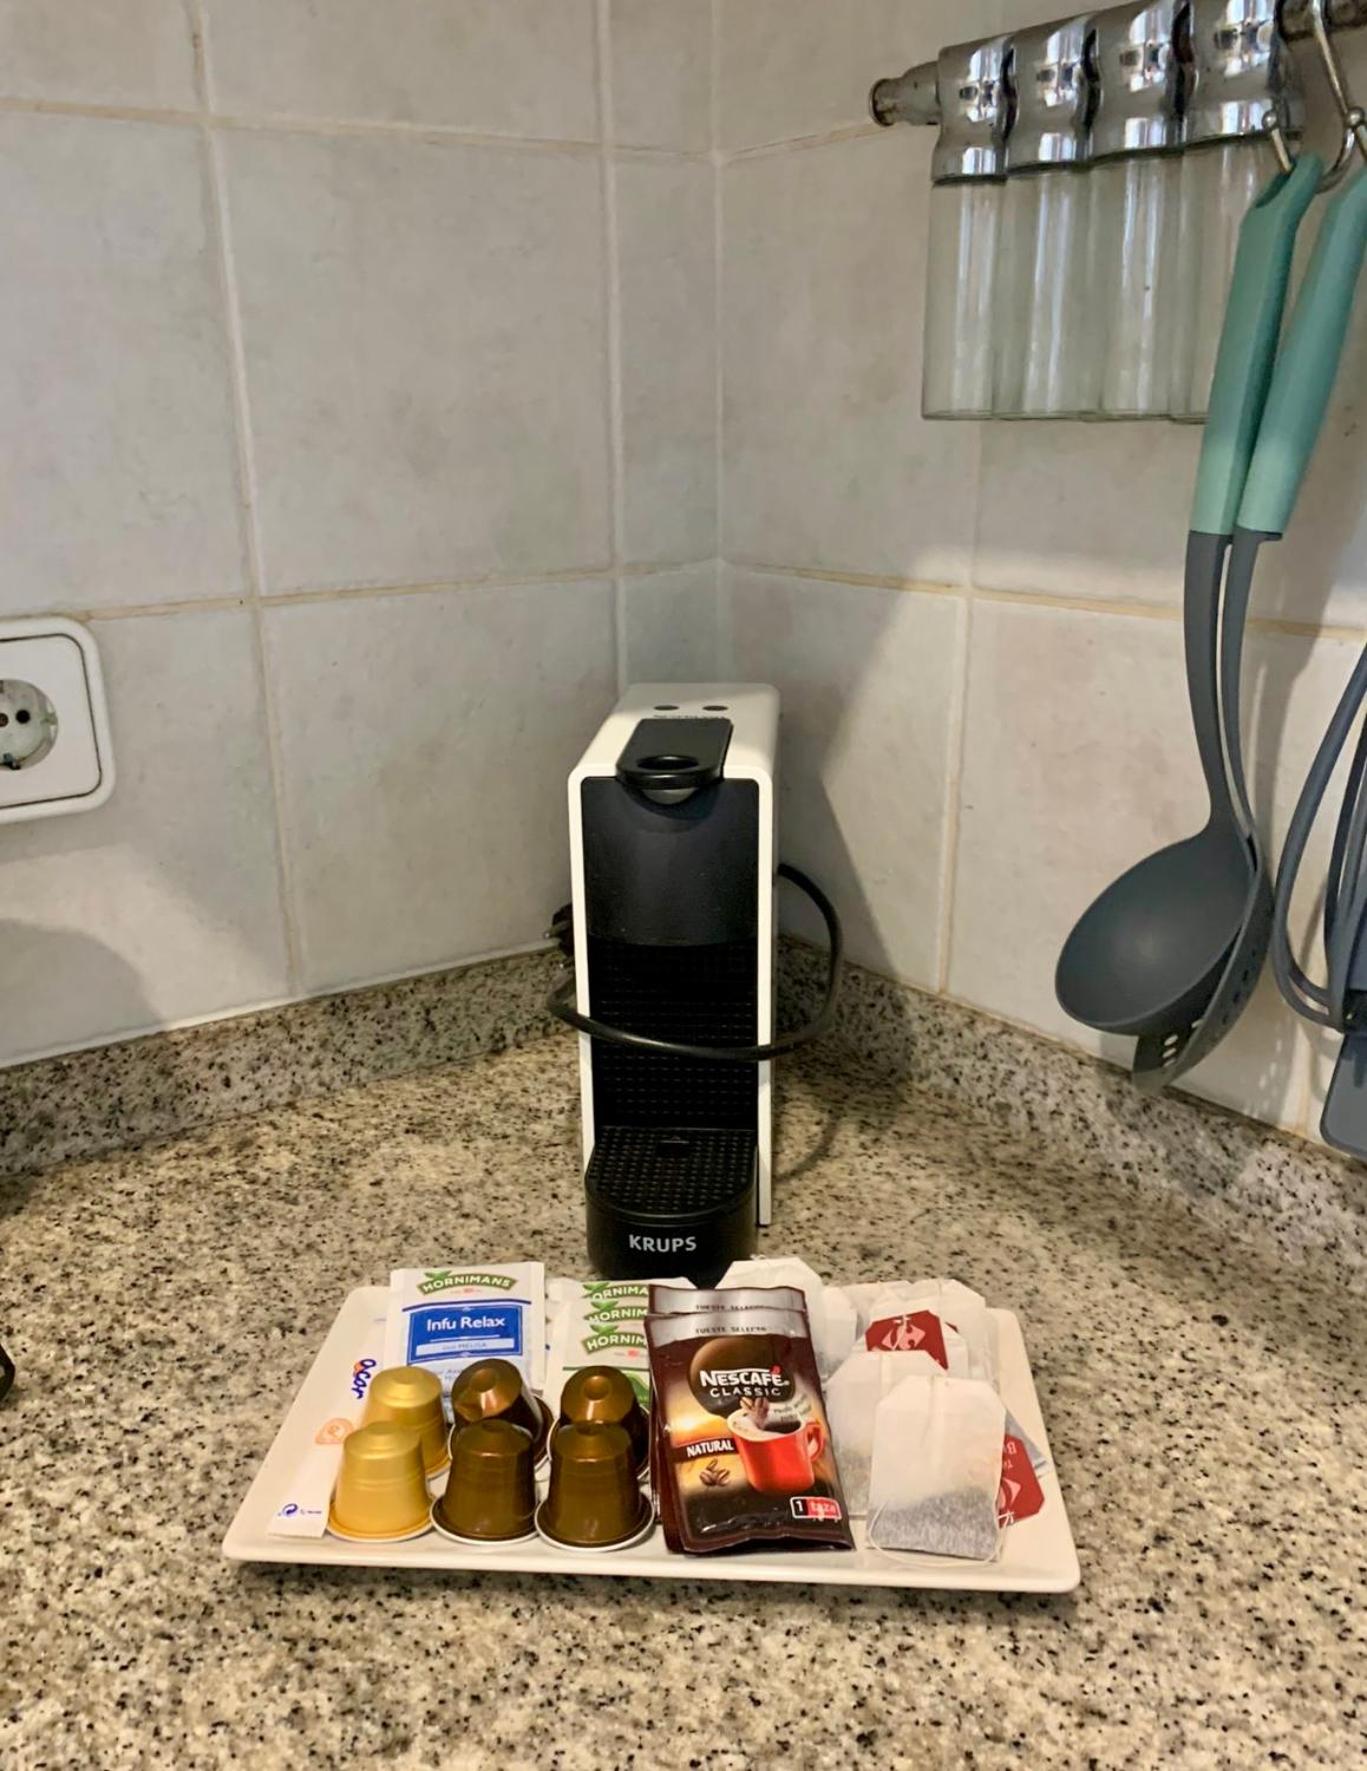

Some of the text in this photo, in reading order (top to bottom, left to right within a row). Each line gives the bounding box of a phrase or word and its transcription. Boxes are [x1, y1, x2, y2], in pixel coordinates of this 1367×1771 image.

[629, 1234, 697, 1253] KRUPS
[421, 1275, 512, 1293] HORNIMANS
[427, 1315, 506, 1332] Infu Relax
[710, 1386, 781, 1398] CLASSIC
[687, 1439, 734, 1458] NATURAL
[795, 1500, 804, 1512] 1
